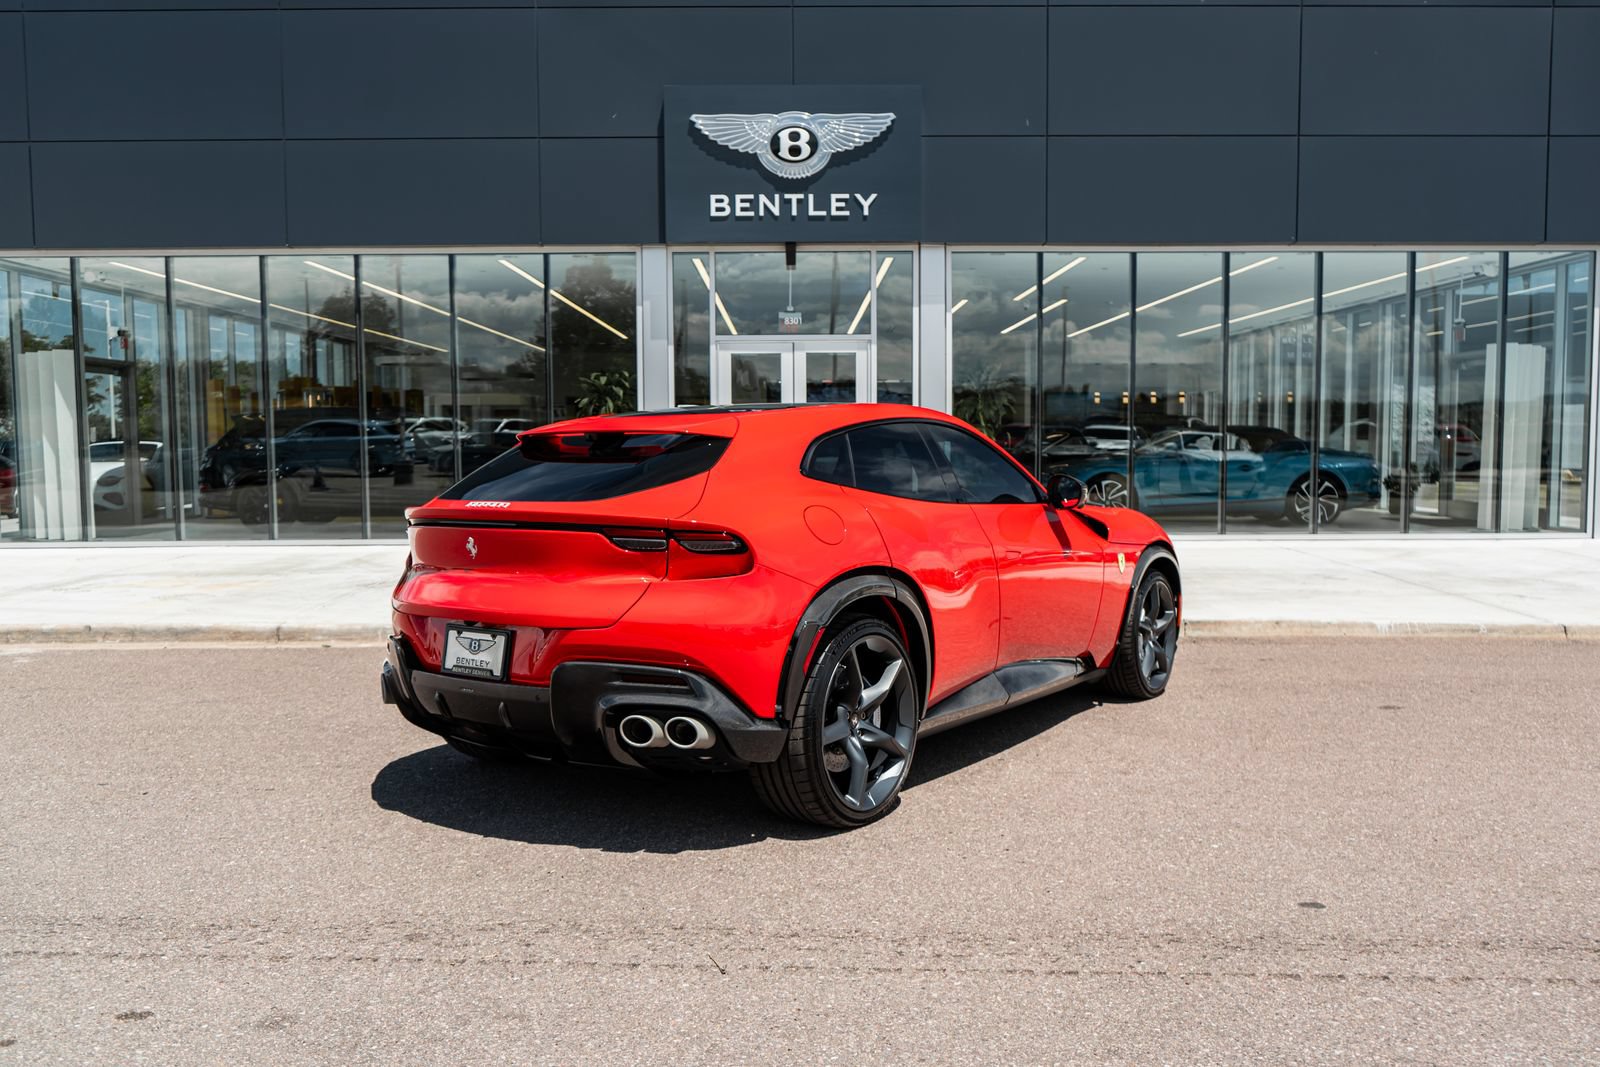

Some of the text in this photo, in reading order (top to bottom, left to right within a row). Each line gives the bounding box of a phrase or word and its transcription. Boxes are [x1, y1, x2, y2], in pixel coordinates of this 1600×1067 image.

[709, 193, 878, 217] BENTLEY
[784, 317, 802, 325] 8301
[456, 657, 490, 667] BENTLEY
